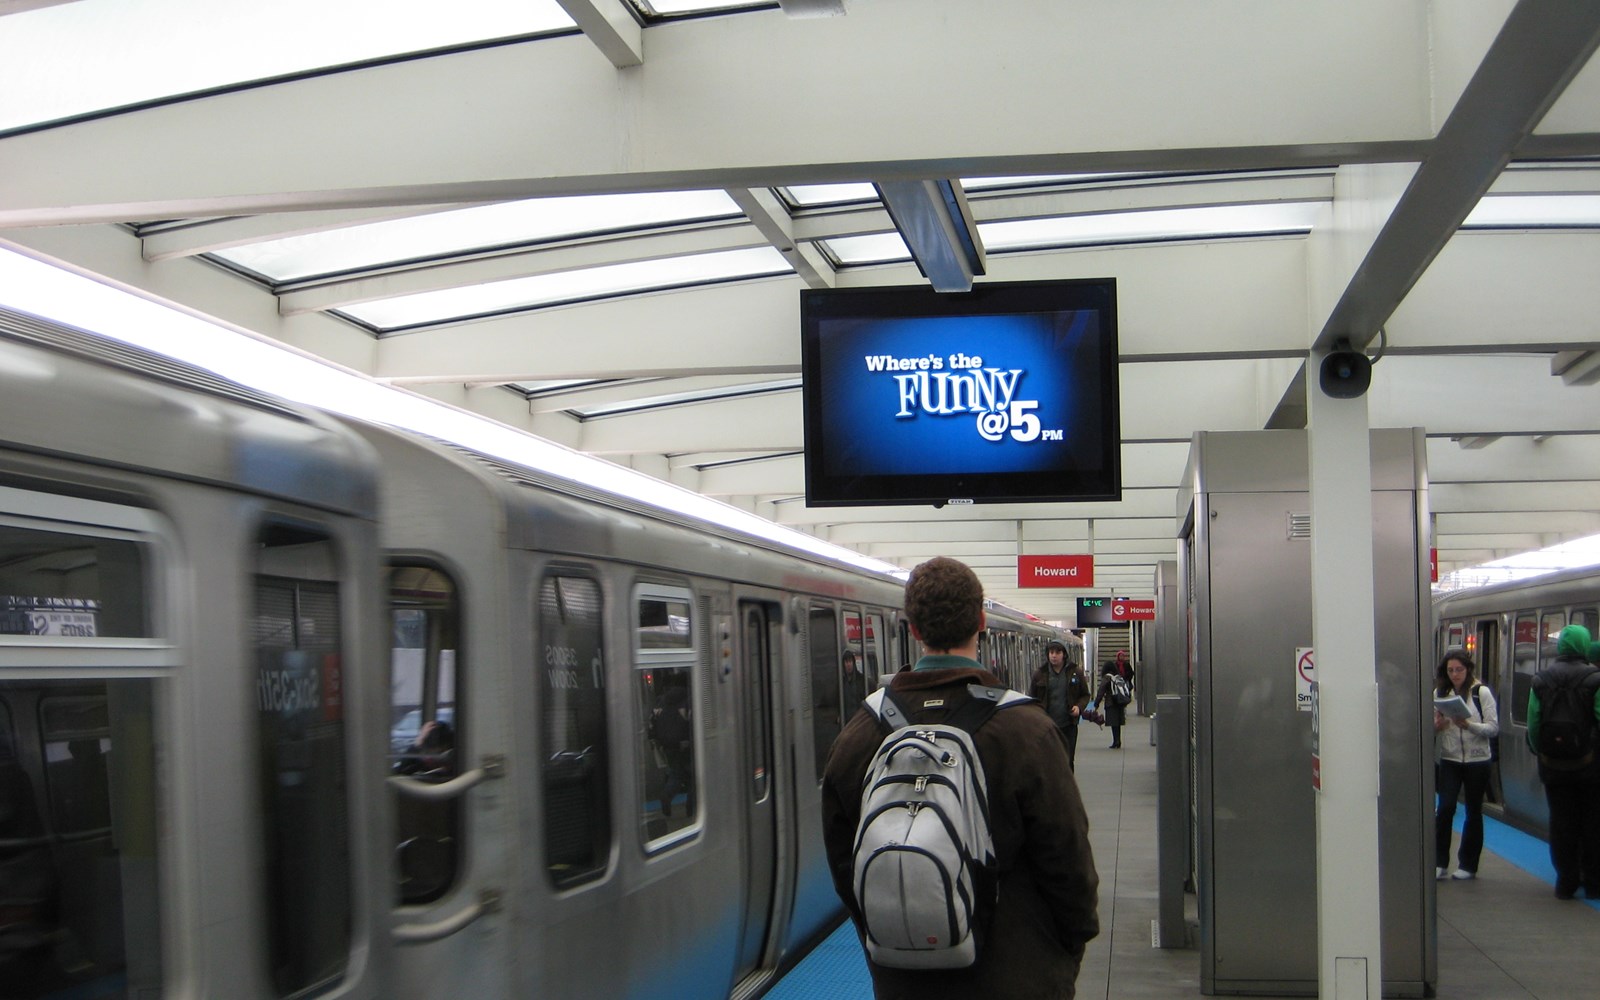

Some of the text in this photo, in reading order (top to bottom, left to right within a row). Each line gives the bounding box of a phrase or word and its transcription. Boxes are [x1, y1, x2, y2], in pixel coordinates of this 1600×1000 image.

[865, 352, 982, 371] Where's the
[1034, 566, 1077, 576] Howard
